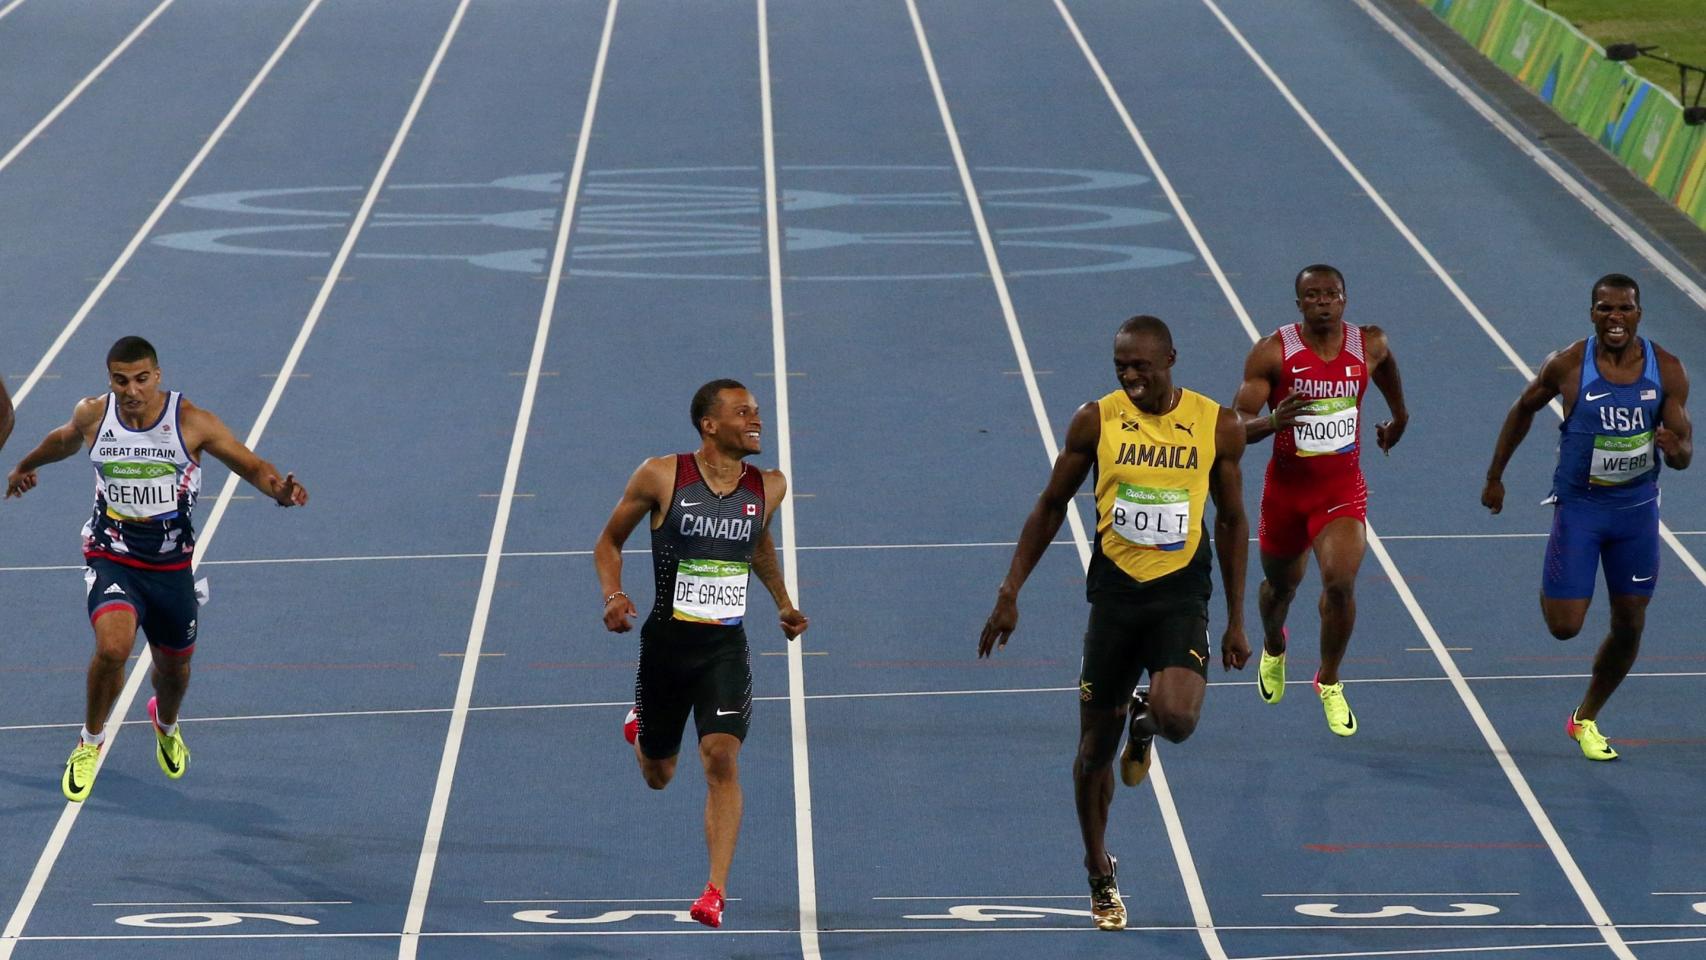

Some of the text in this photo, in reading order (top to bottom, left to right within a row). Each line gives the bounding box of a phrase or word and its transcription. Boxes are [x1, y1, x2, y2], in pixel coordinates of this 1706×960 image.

[1294, 378, 1360, 398] BAHRAIN
[1296, 418, 1355, 441] YAQOOB
[1599, 406, 1645, 432] USA
[99, 447, 176, 458] GREAT BRITAIN
[1114, 442, 1198, 470] JAMAICA
[1603, 453, 1648, 472] WEBB
[107, 484, 175, 505] GEMILI
[680, 513, 752, 542] CANADA
[1114, 507, 1188, 534] BOLT
[676, 581, 746, 607] DE GRASSE
[115, 911, 320, 928] 6
[1294, 903, 1500, 918] 3
